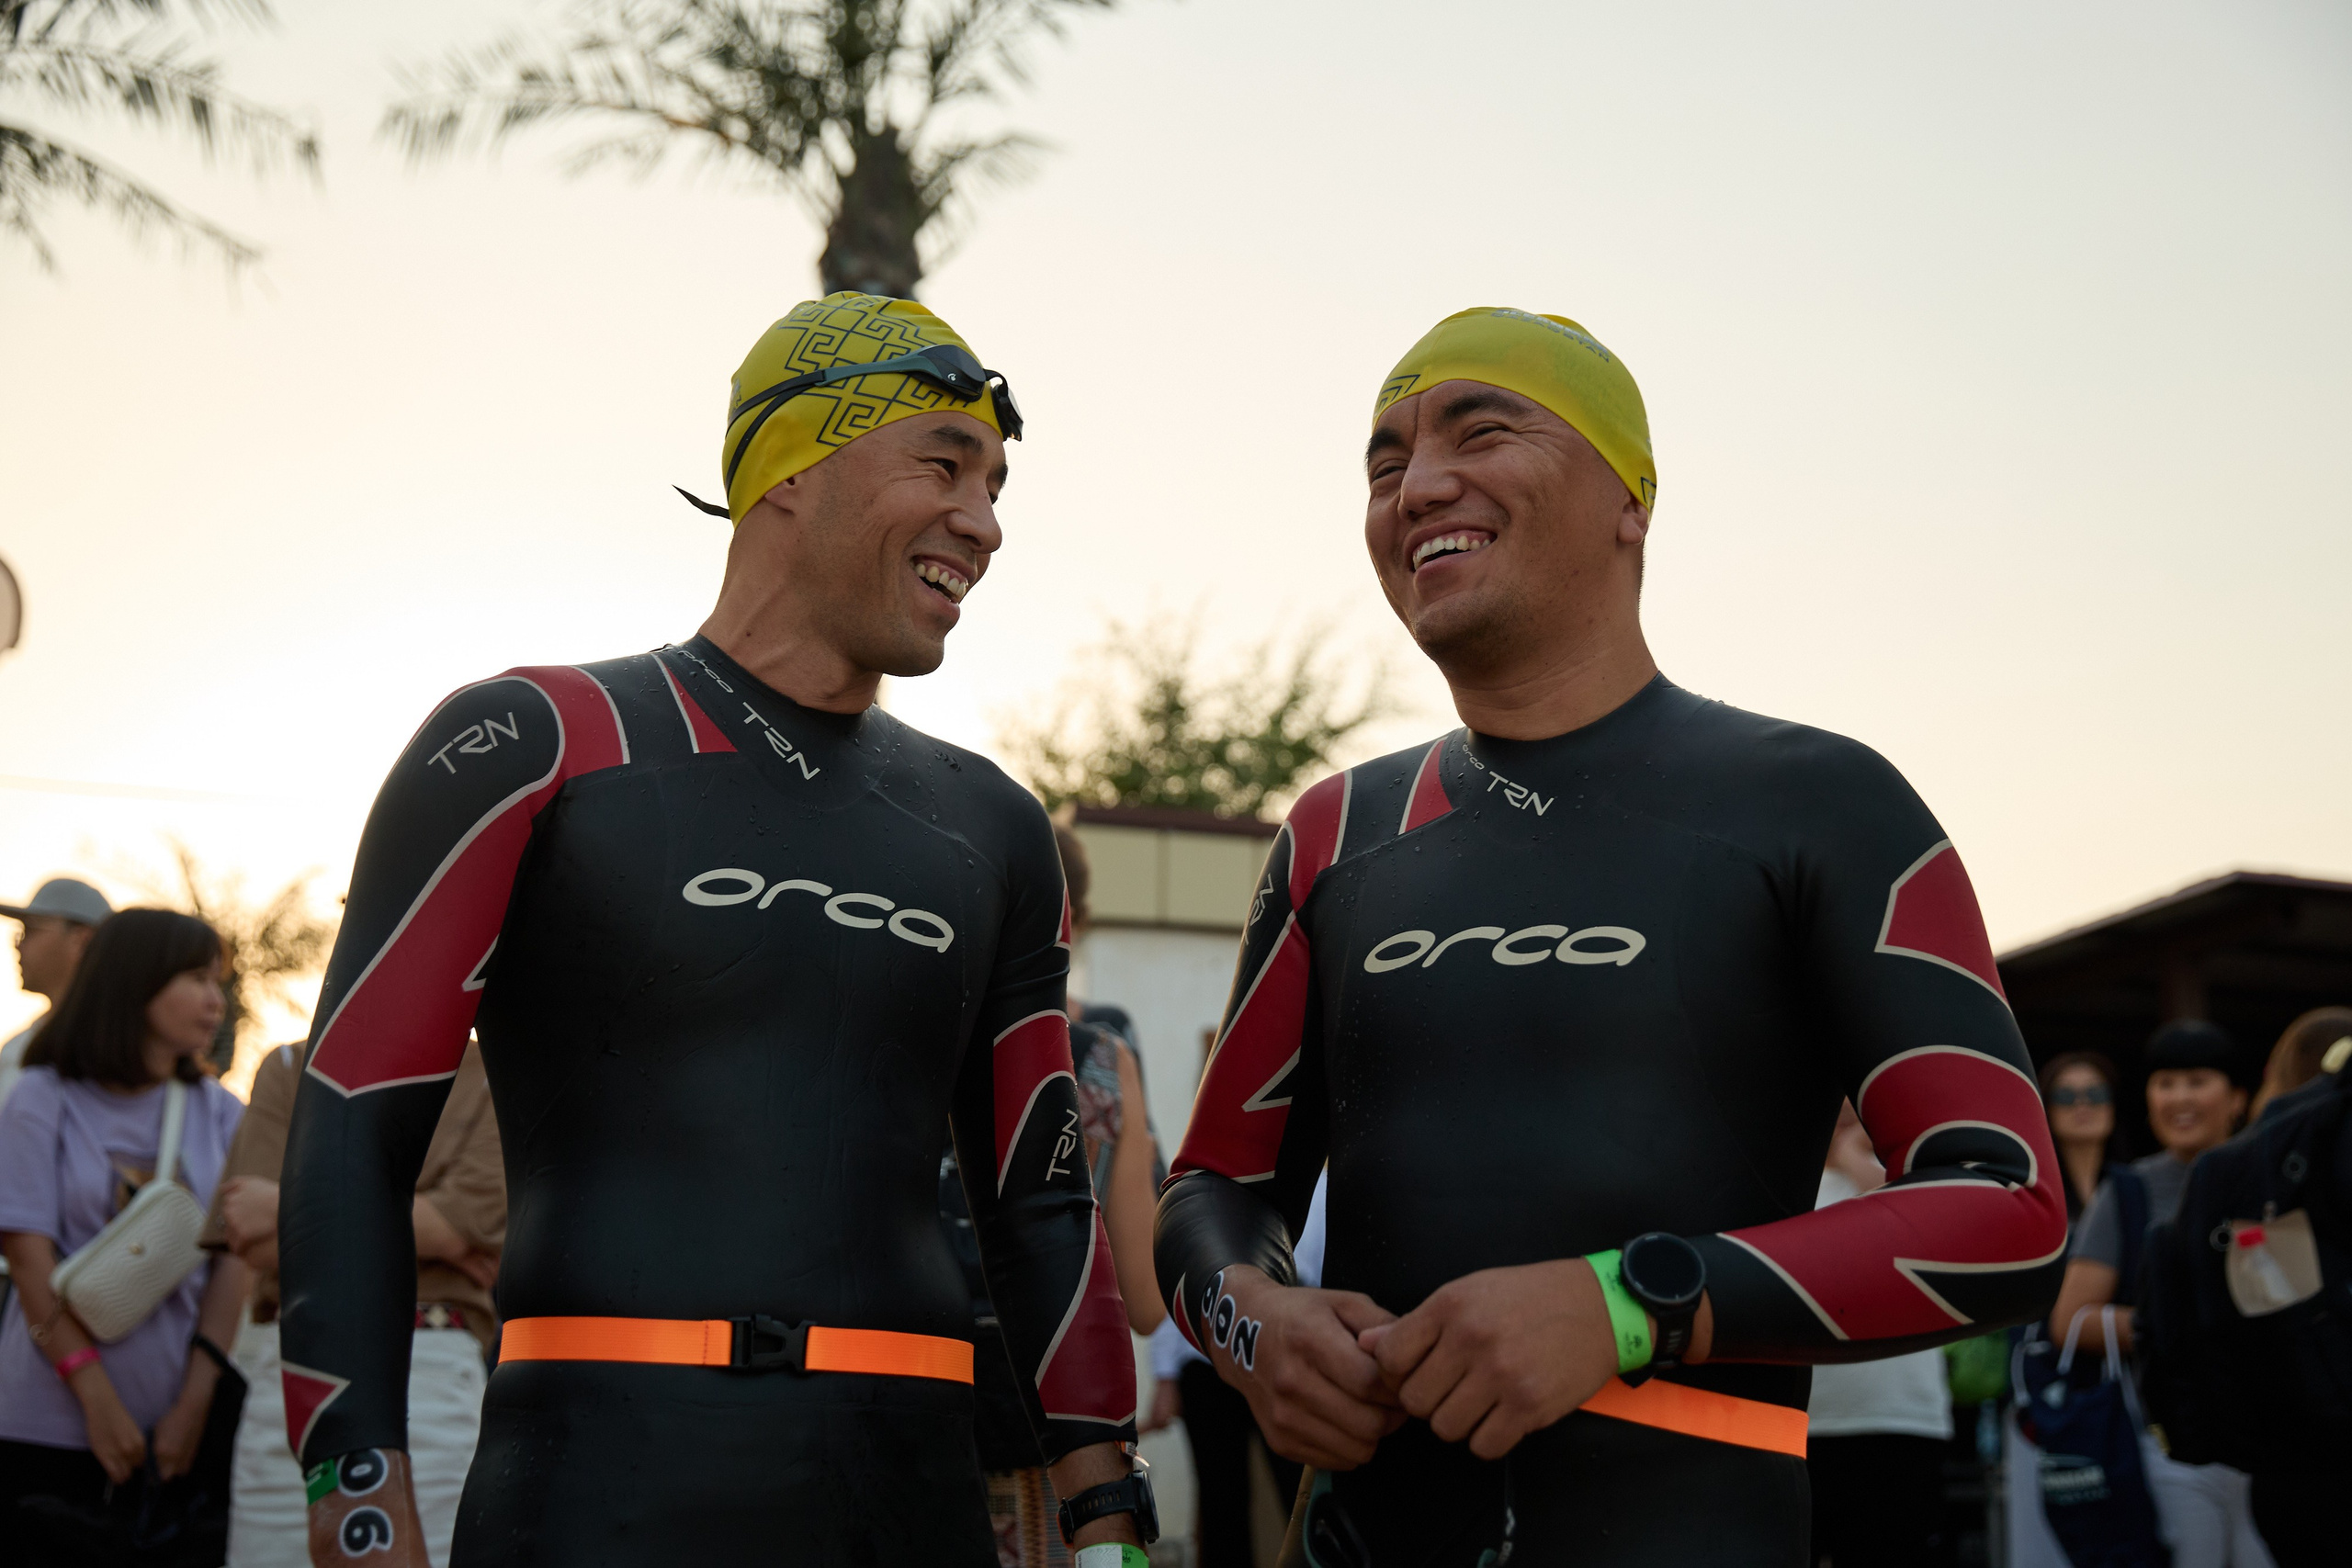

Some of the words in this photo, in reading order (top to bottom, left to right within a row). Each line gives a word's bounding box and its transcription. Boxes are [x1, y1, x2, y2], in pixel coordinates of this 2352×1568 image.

[427, 711, 519, 774] TRN
[742, 701, 822, 781] TRN
[1462, 744, 1486, 771] orca
[1487, 771, 1555, 817] TRN
[682, 867, 956, 953] orca
[1363, 924, 1647, 974] orca
[1046, 1108, 1079, 1181] TRN
